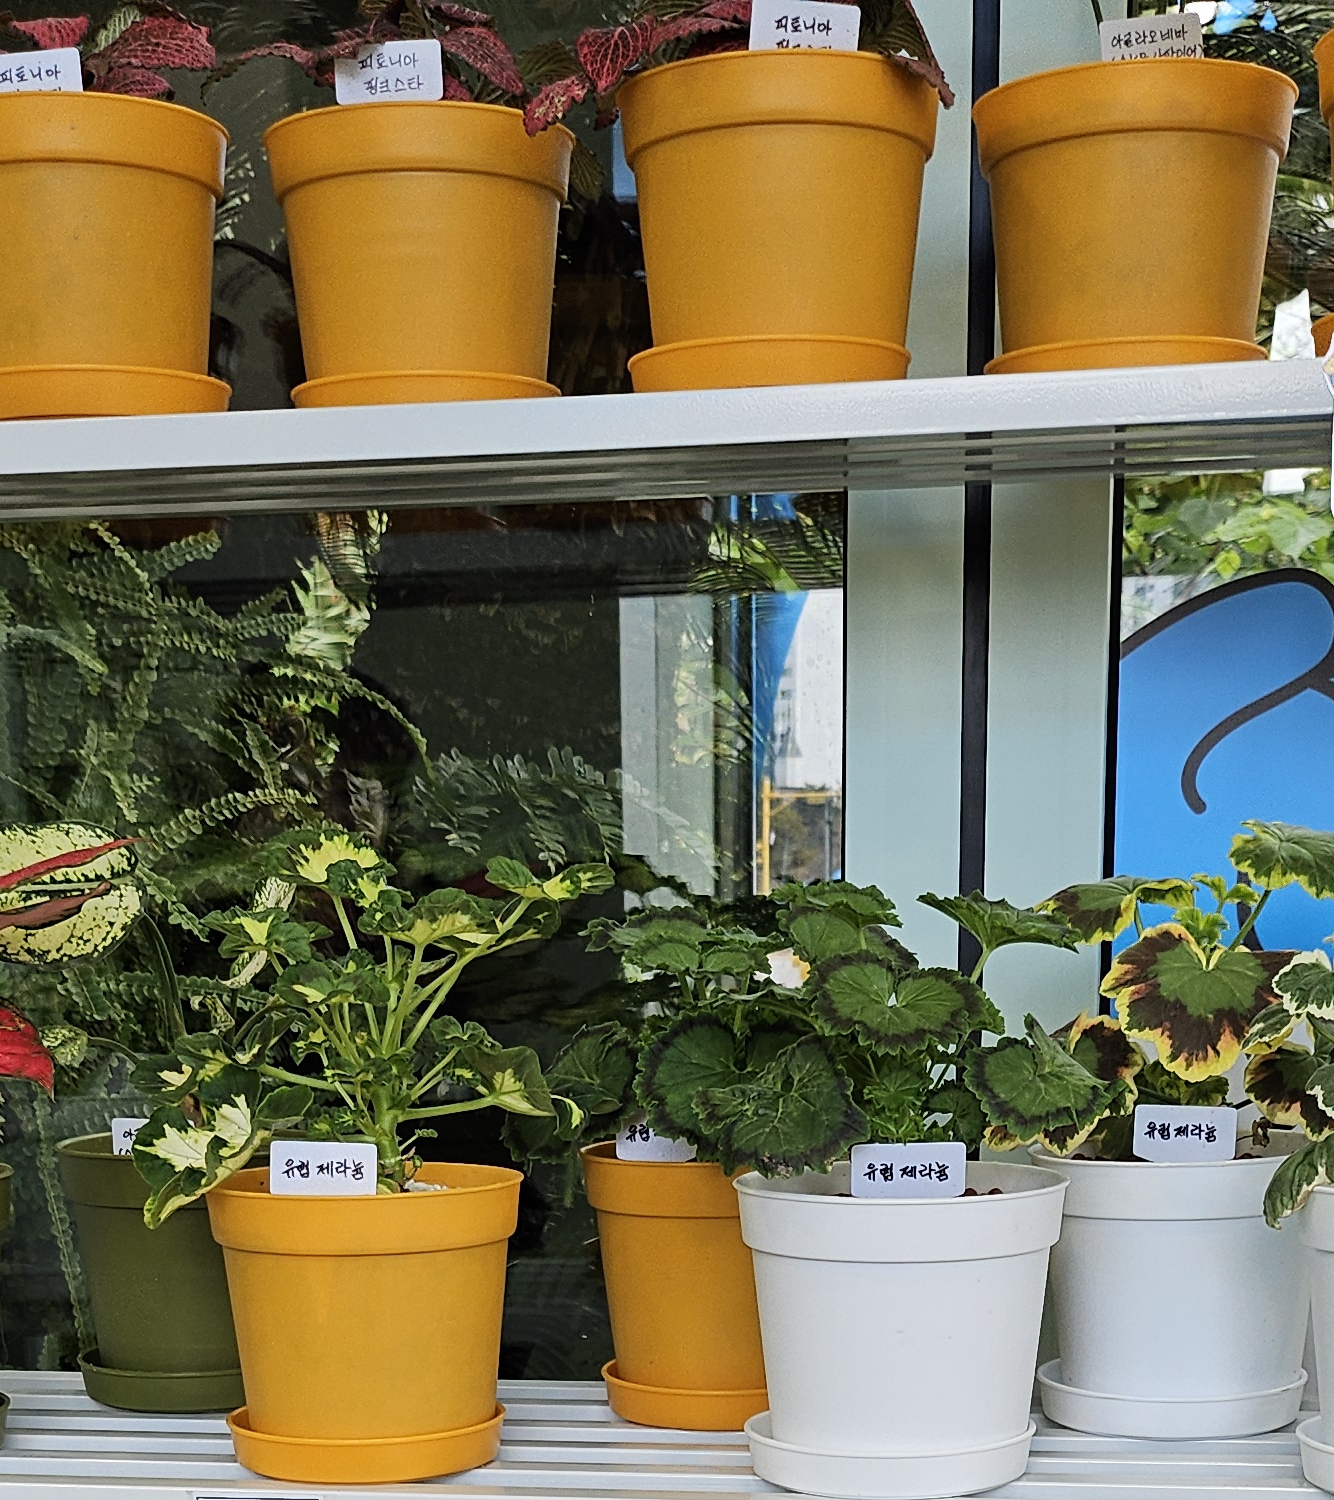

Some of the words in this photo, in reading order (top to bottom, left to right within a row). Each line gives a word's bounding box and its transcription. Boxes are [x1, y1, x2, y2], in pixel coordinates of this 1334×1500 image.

[774, 15, 833, 37] 피토니아
[357, 51, 419, 71] 피토니아
[362, 78, 425, 95] 핑크스타
